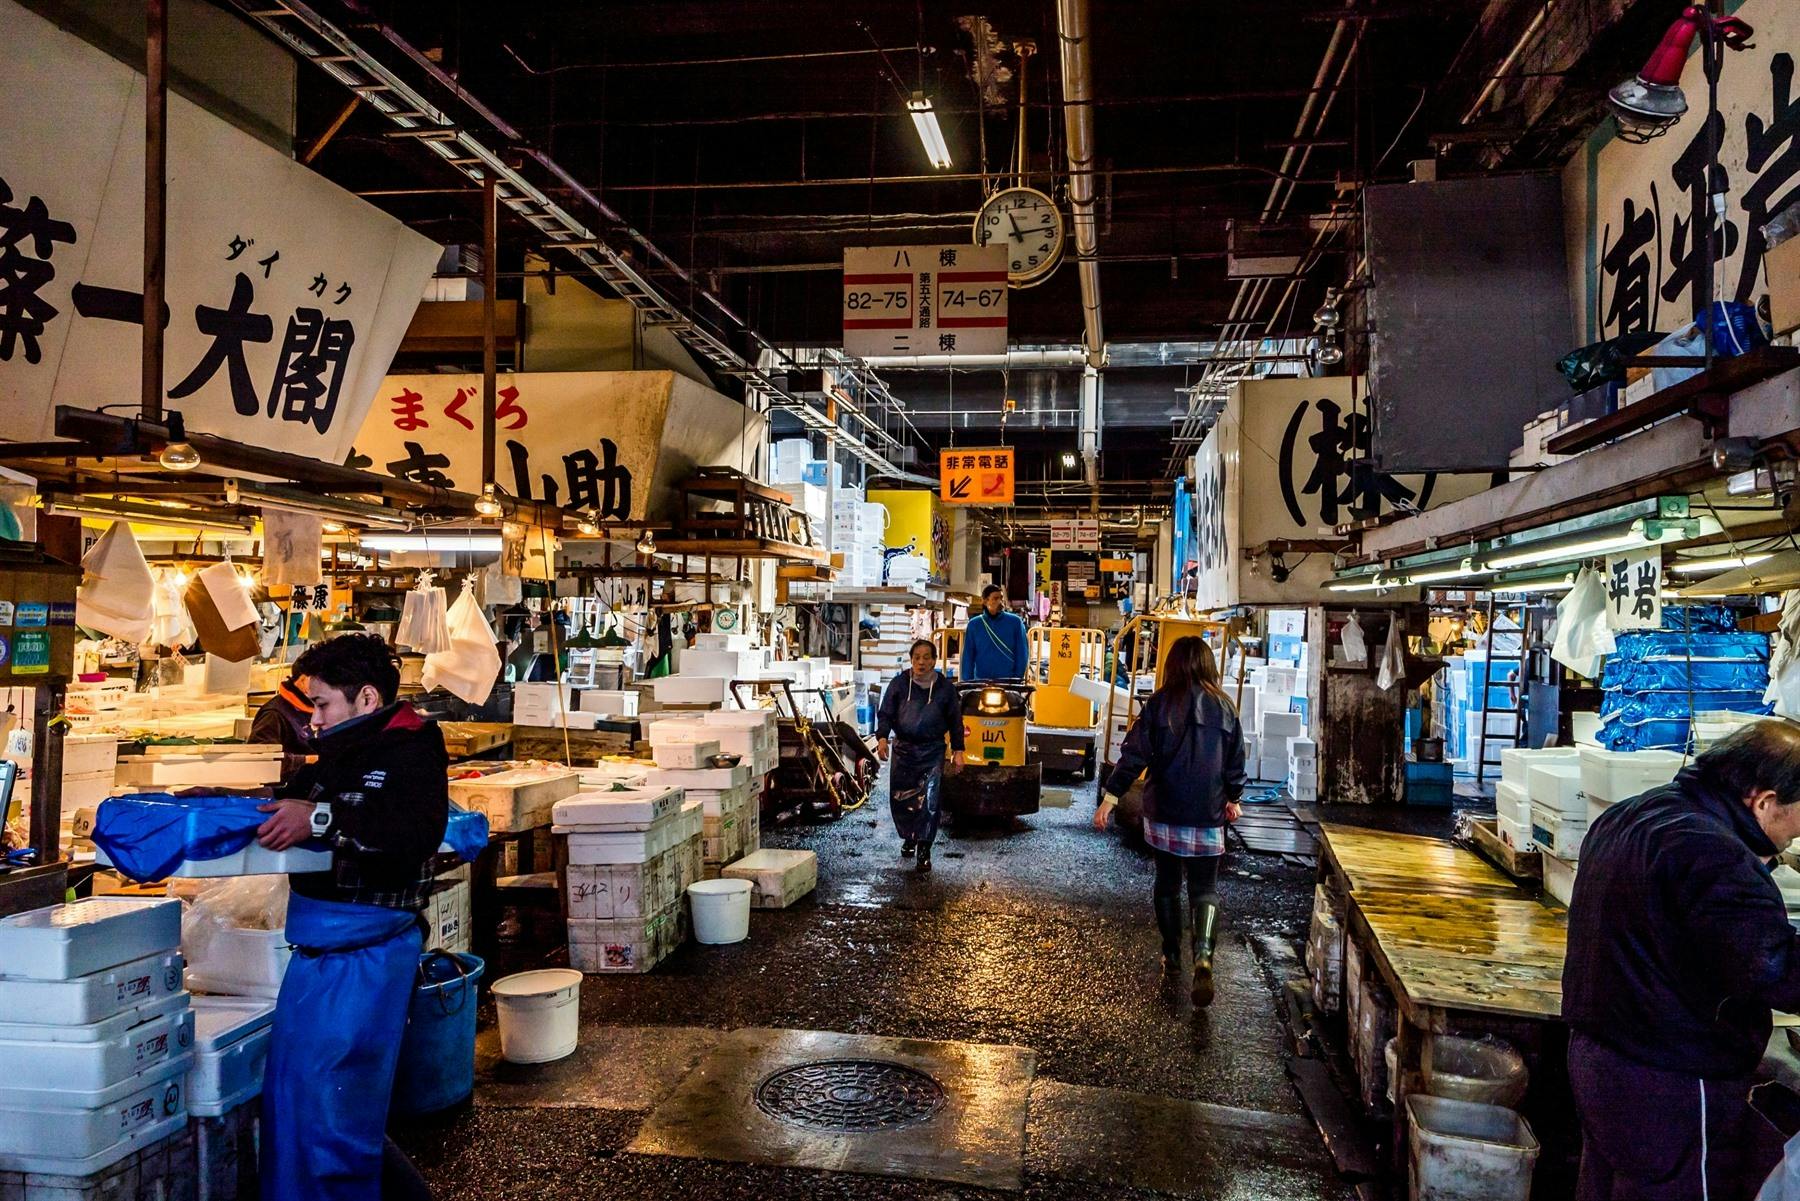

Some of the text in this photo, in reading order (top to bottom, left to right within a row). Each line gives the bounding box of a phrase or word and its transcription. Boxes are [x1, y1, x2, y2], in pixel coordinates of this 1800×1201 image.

[987, 216, 1000, 225] 10
[1041, 214, 1051, 223] 2
[1044, 230, 1054, 238] 3
[1038, 243, 1049, 252] 4
[1028, 256, 1038, 265] 5
[1012, 261, 1021, 270] 6
[847, 291, 908, 310] 82-75
[942, 289, 1004, 307] 74-67
[391, 386, 528, 431] まぐろ
[946, 454, 1008, 470] 非常電話
[1609, 558, 1657, 621] 平岩
